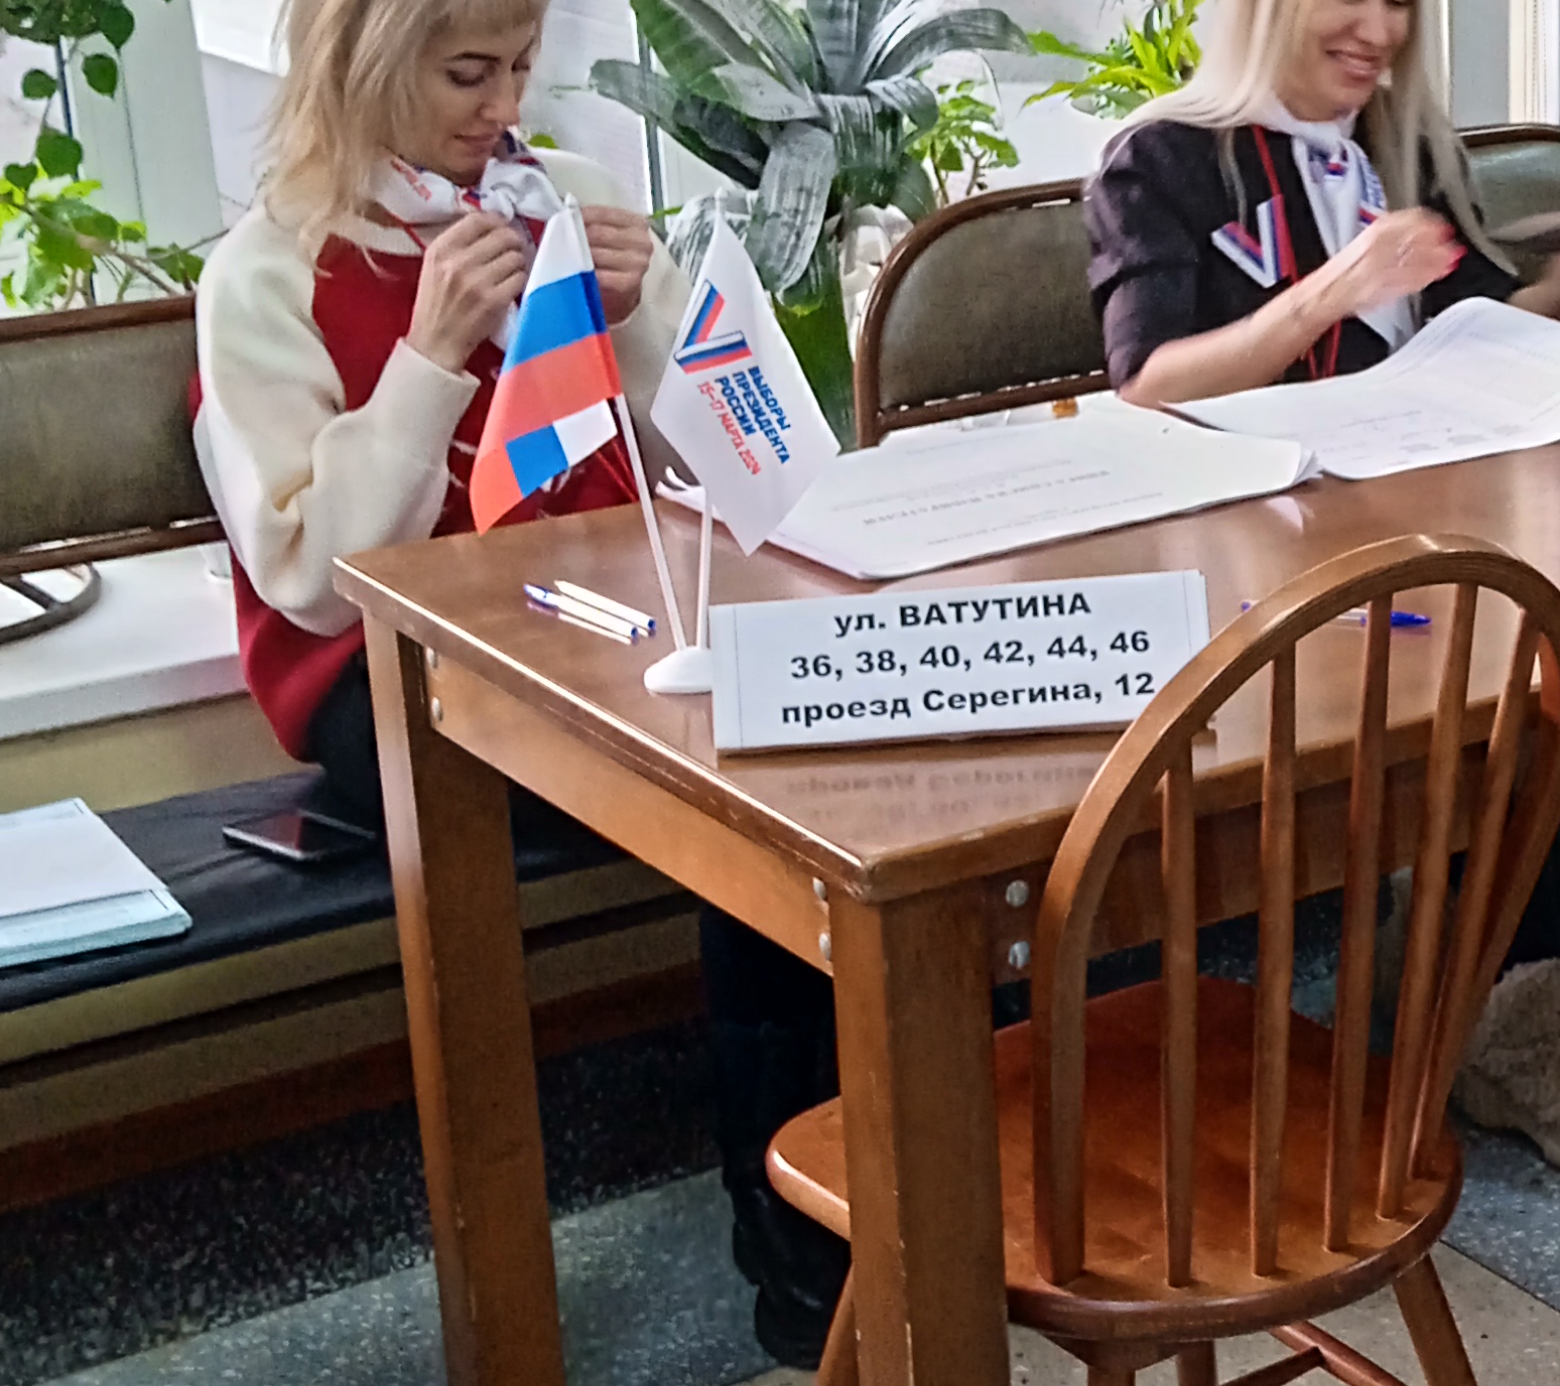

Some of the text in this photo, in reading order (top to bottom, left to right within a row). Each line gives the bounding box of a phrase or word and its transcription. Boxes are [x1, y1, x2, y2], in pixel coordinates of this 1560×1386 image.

[714, 376, 756, 436] РОССИИ
[732, 371, 790, 464] ПРЕЗИДЕНТА
[748, 365, 791, 431] ВЫБОРЫ
[717, 413, 745, 450] МАРТА
[738, 449, 761, 475] 2024
[834, 592, 1091, 637] ул. ВАТУТИНА
[790, 630, 1150, 682] 36, 38, 40, 42, 44, 46
[782, 673, 1155, 728] проезд Серегина, 12
